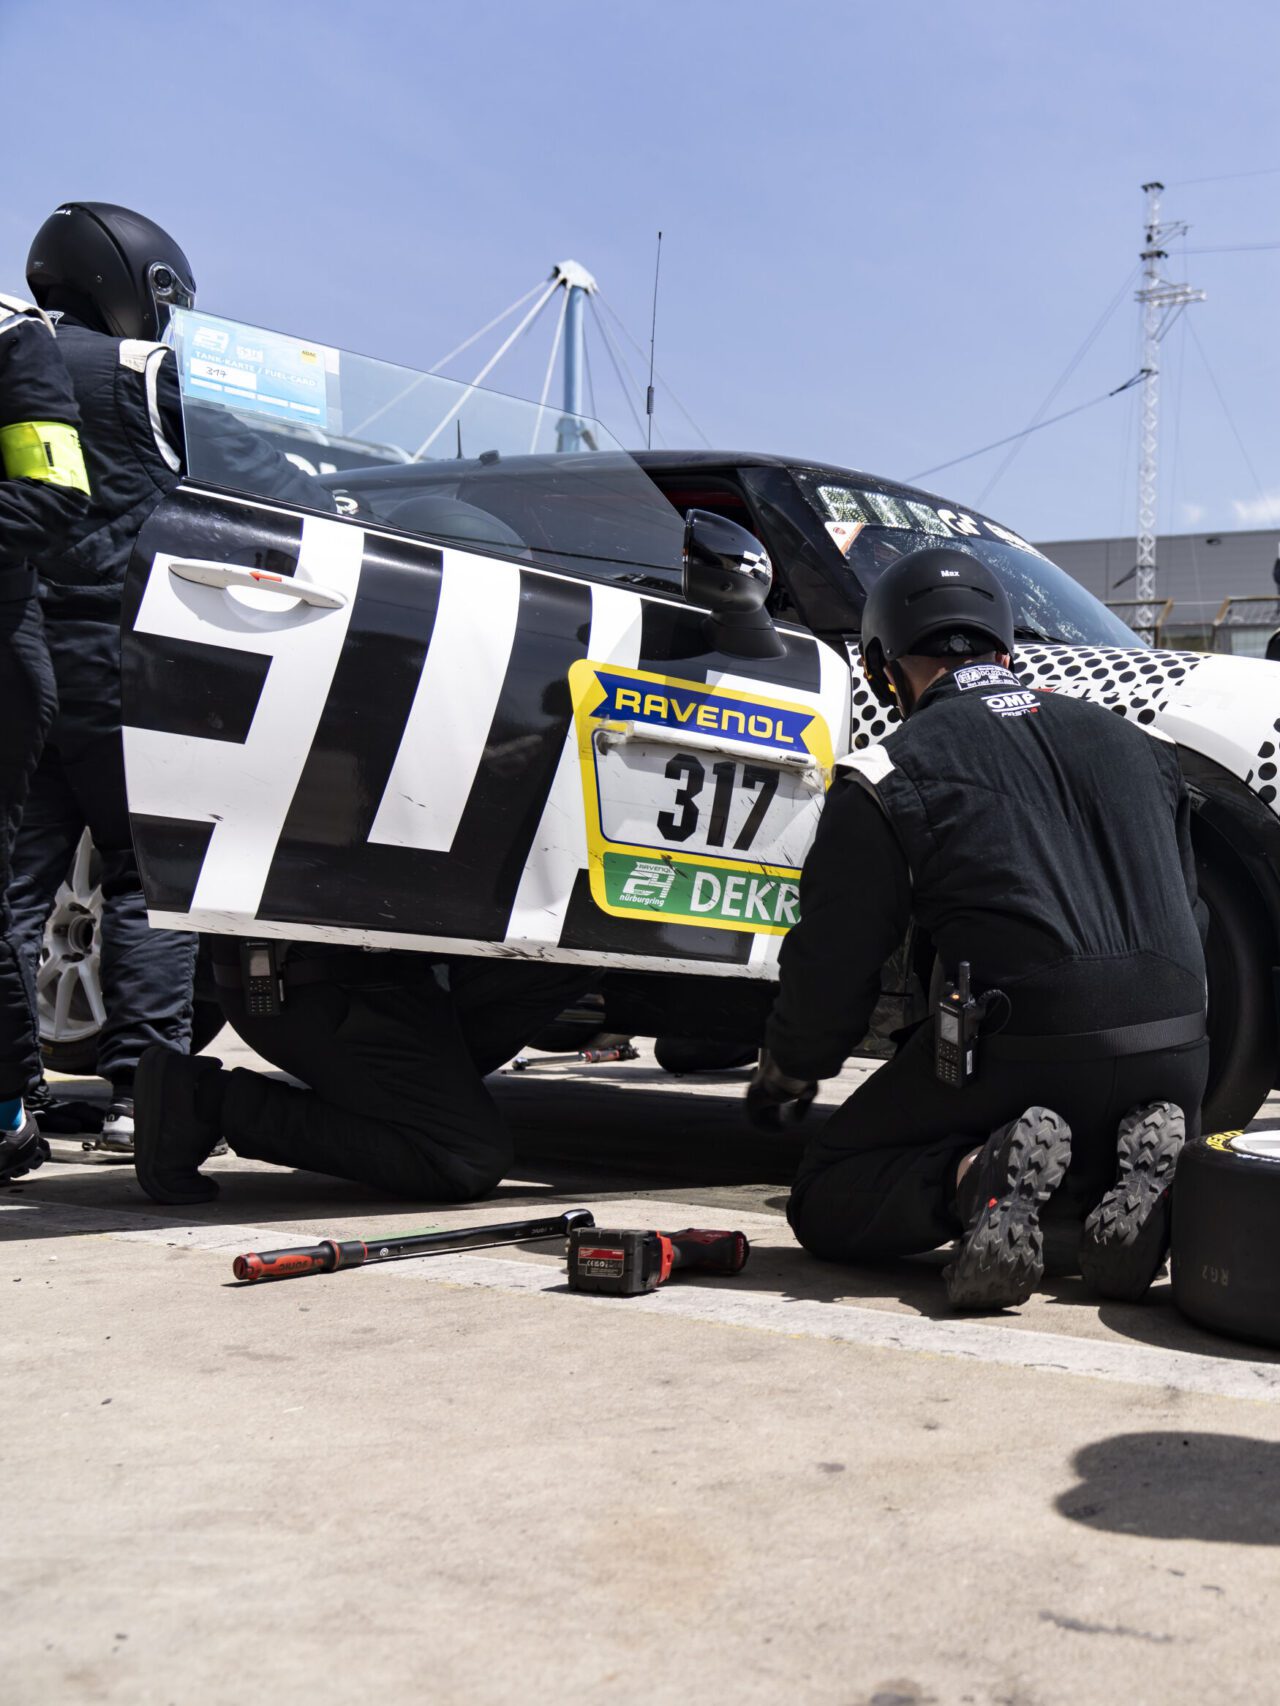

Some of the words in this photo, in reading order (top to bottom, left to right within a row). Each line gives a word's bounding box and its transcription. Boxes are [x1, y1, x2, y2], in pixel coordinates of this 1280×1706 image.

[940, 569, 960, 577] Max
[614, 687, 794, 744] RAVENOL
[986, 693, 1036, 709] OMP
[656, 752, 781, 852] 317
[689, 871, 802, 925] DEKR
